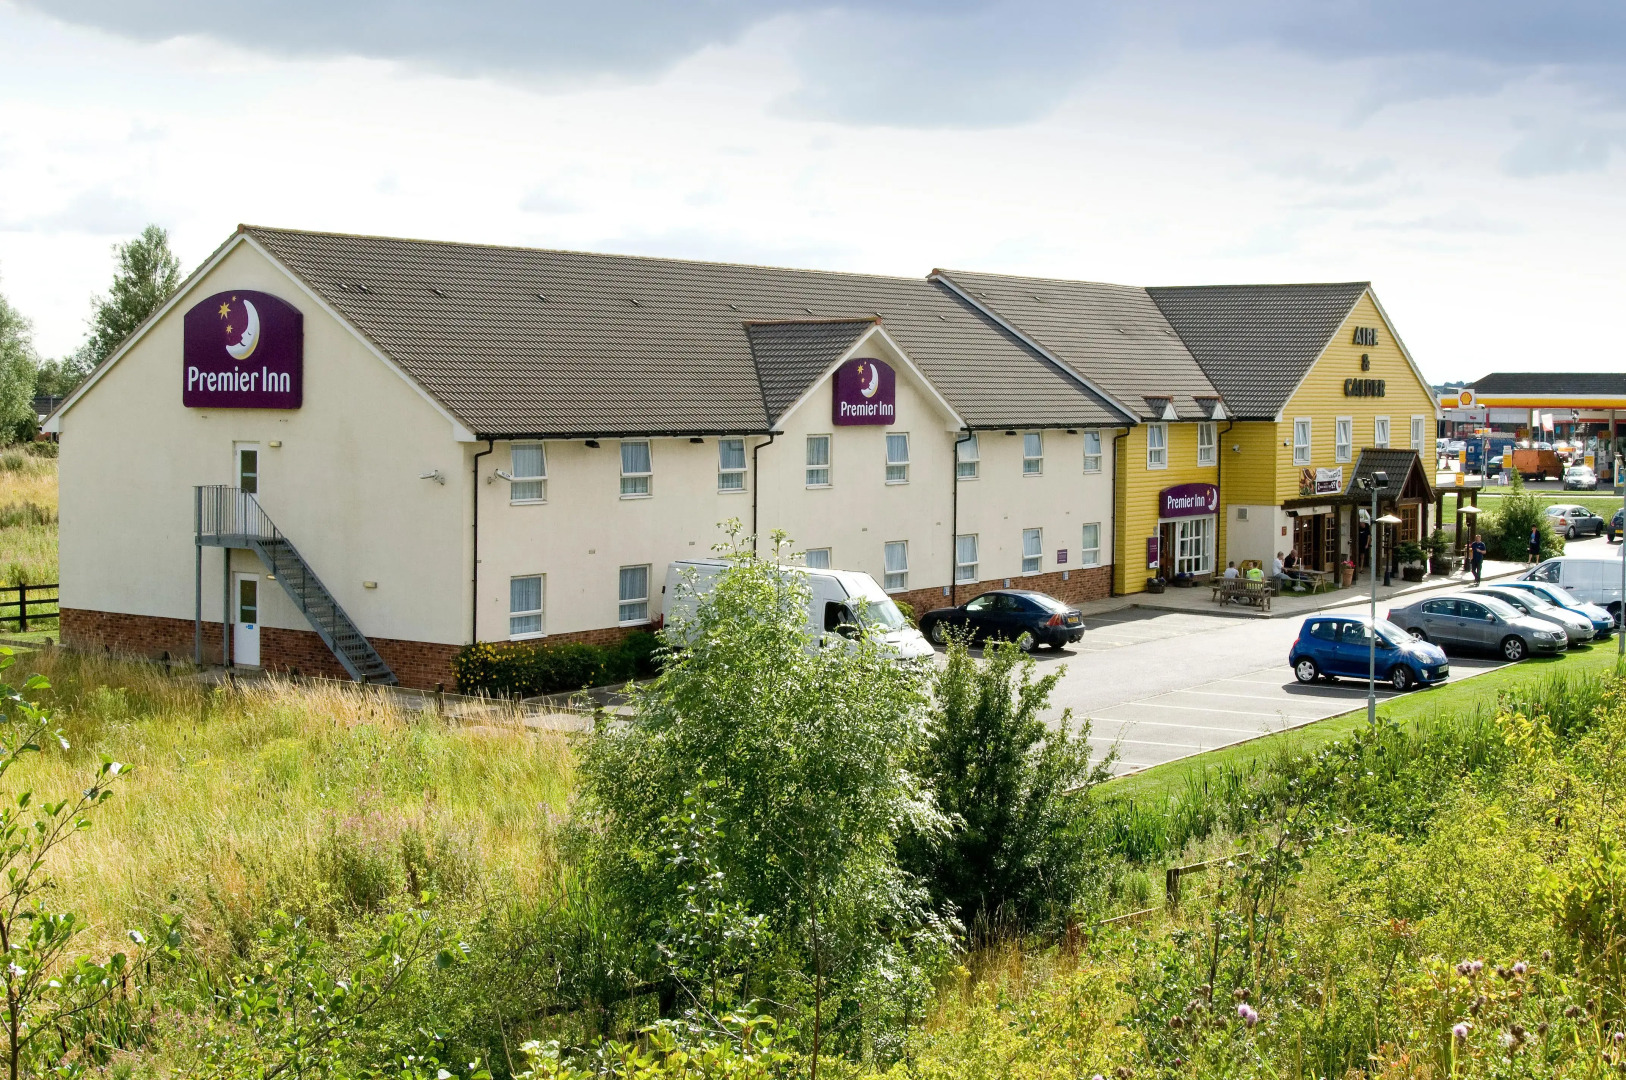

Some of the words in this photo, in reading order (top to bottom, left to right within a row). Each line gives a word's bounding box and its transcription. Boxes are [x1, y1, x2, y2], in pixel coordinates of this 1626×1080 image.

[1352, 326, 1379, 346] AIRE
[1361, 353, 1370, 371] &
[187, 365, 259, 392] Premier
[262, 366, 290, 392] Inn
[1344, 378, 1386, 397] CALDER
[840, 400, 878, 416] Premier
[879, 400, 894, 416] Inn
[1167, 494, 1194, 510] Premier
[1194, 493, 1205, 507] Inn
